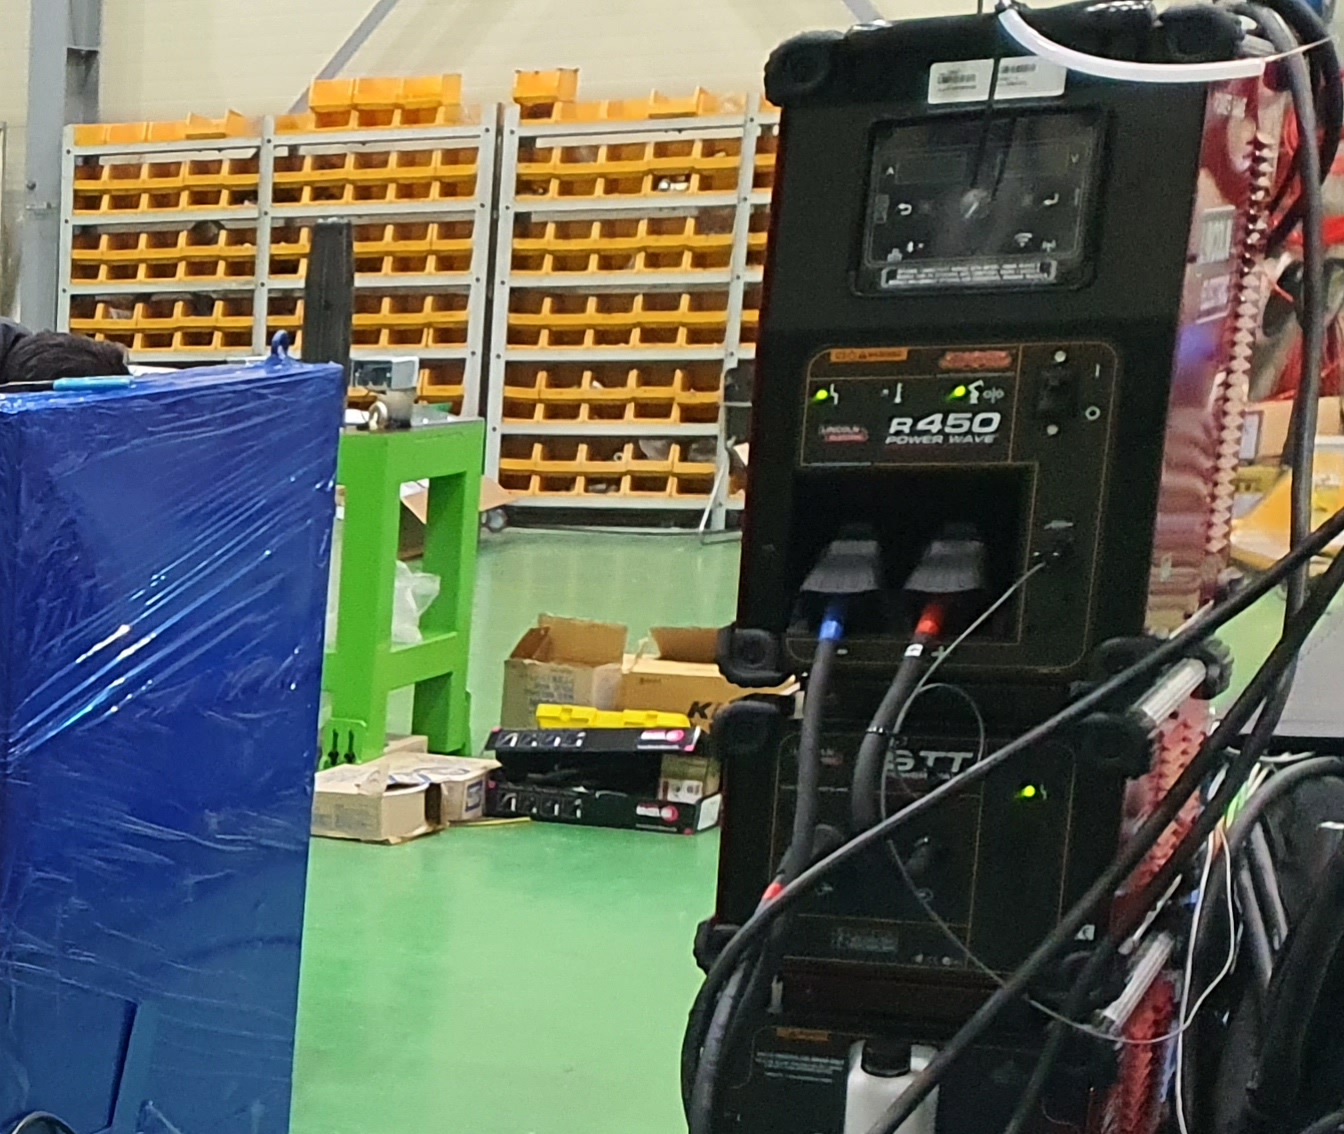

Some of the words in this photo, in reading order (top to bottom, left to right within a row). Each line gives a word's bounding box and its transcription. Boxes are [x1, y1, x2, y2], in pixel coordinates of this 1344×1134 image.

[888, 412, 1002, 435] R450
[885, 435, 943, 445] POWER
[949, 433, 999, 444] WAVE
